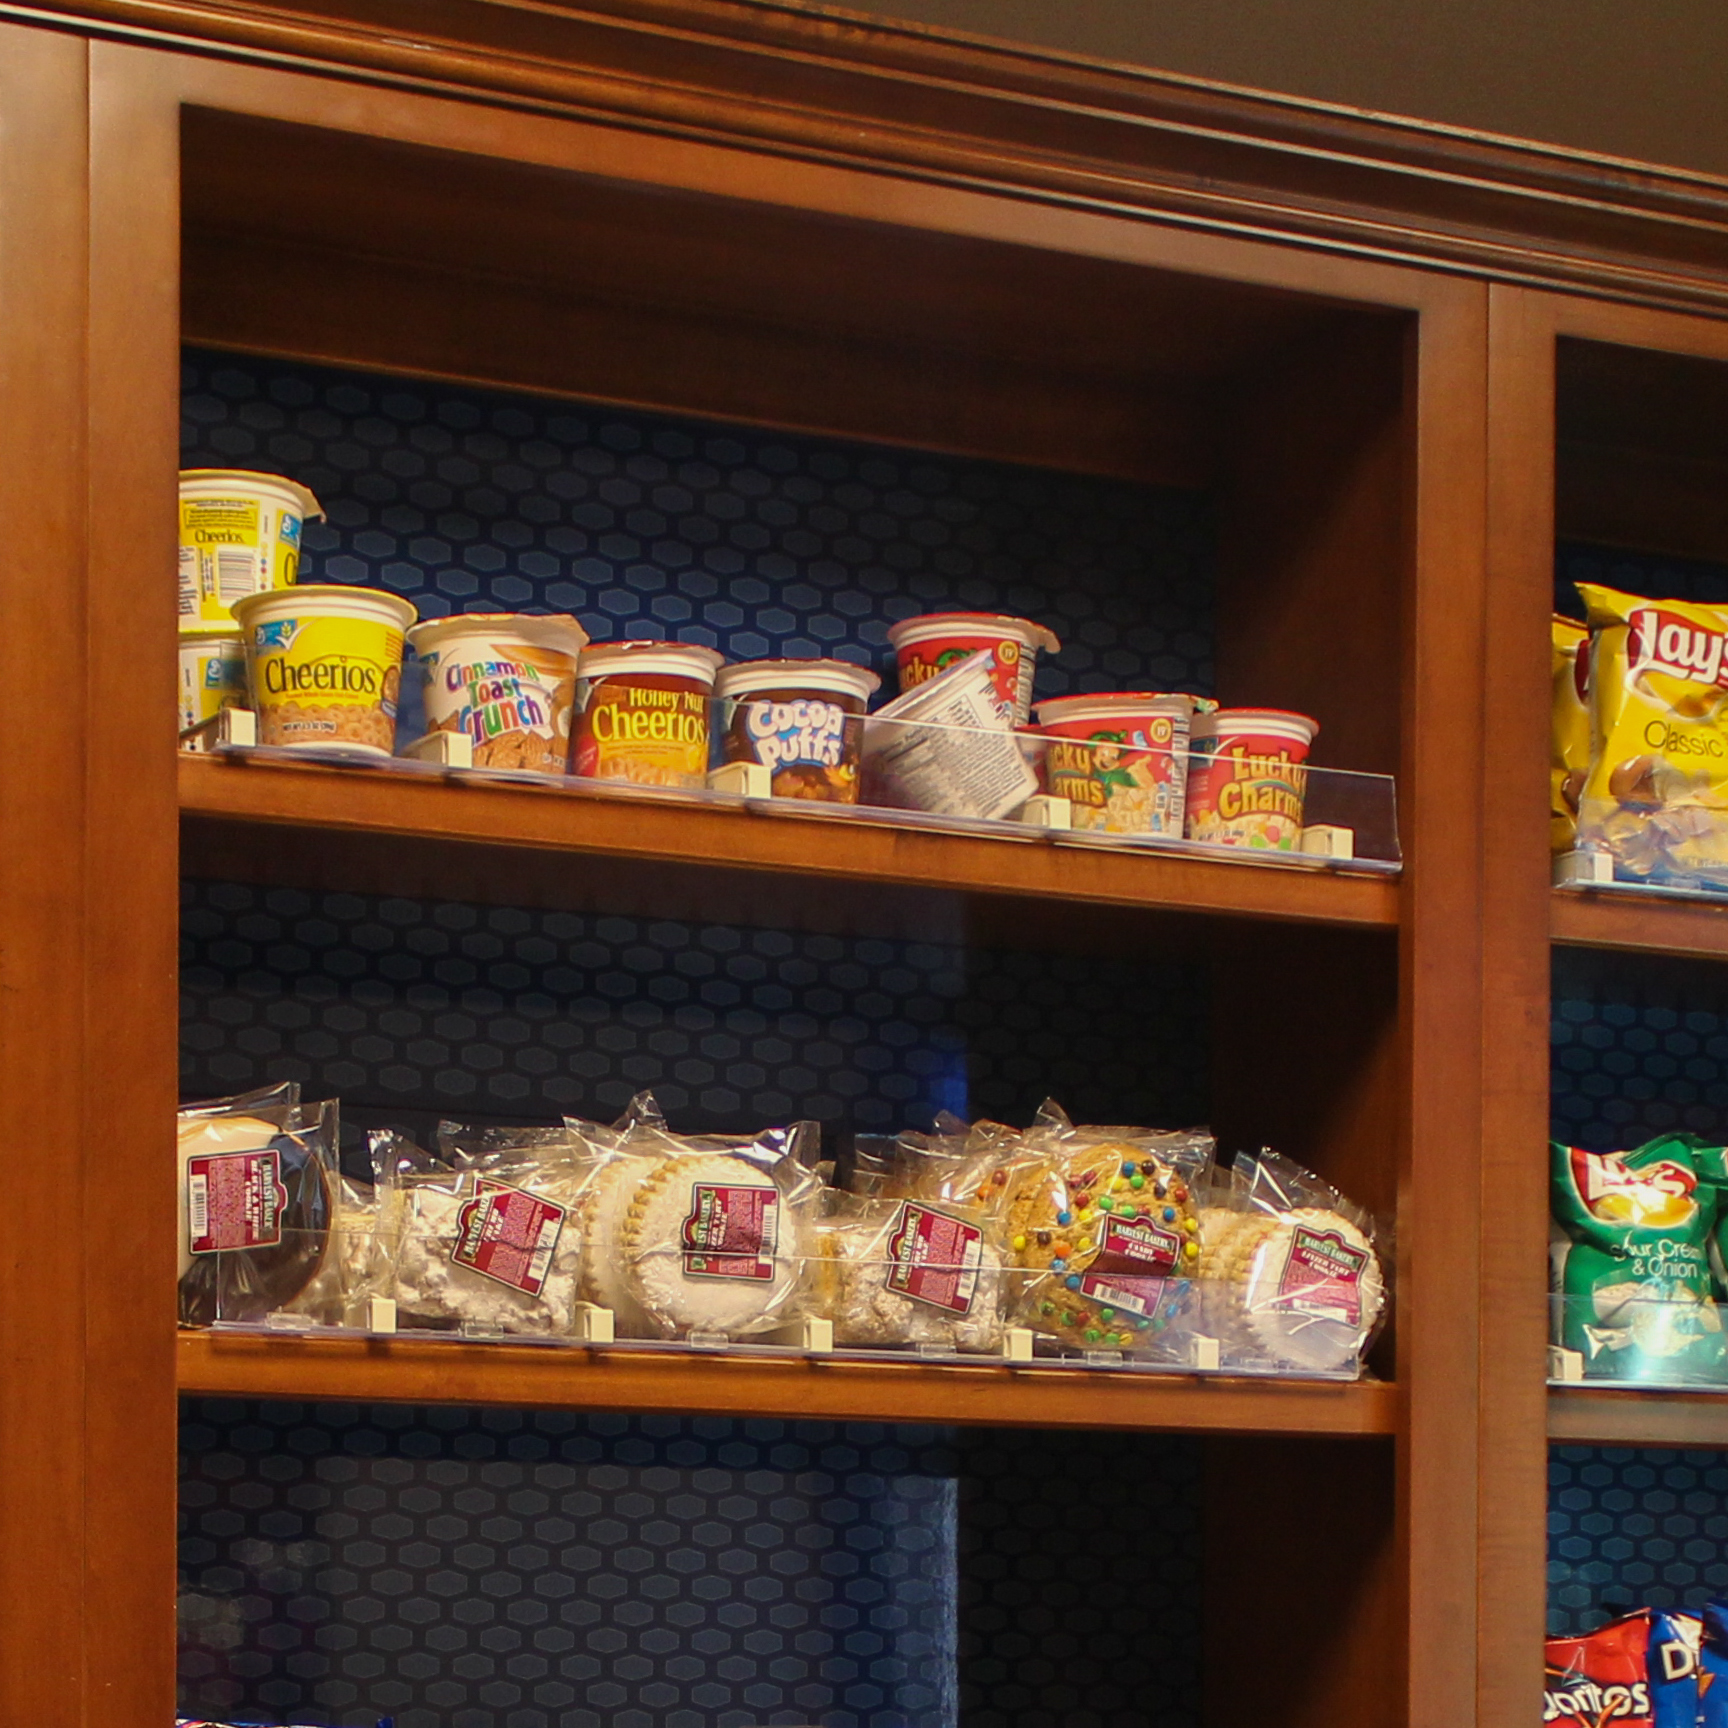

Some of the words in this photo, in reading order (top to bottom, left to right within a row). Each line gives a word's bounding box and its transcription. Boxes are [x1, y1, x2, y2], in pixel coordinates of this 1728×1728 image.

[195, 528, 245, 545] Cheerios
[265, 655, 376, 694] Cheerios
[446, 660, 540, 693] Cinnamon
[470, 676, 524, 709] Toast
[630, 687, 681, 711] Honey
[459, 696, 544, 746] Crunch
[593, 703, 706, 745] Cheerios
[1643, 720, 1725, 758] Classic
[1232, 745, 1308, 787] Lucky
[1632, 1258, 1645, 1276] &
[1648, 1256, 1699, 1279] Onion
